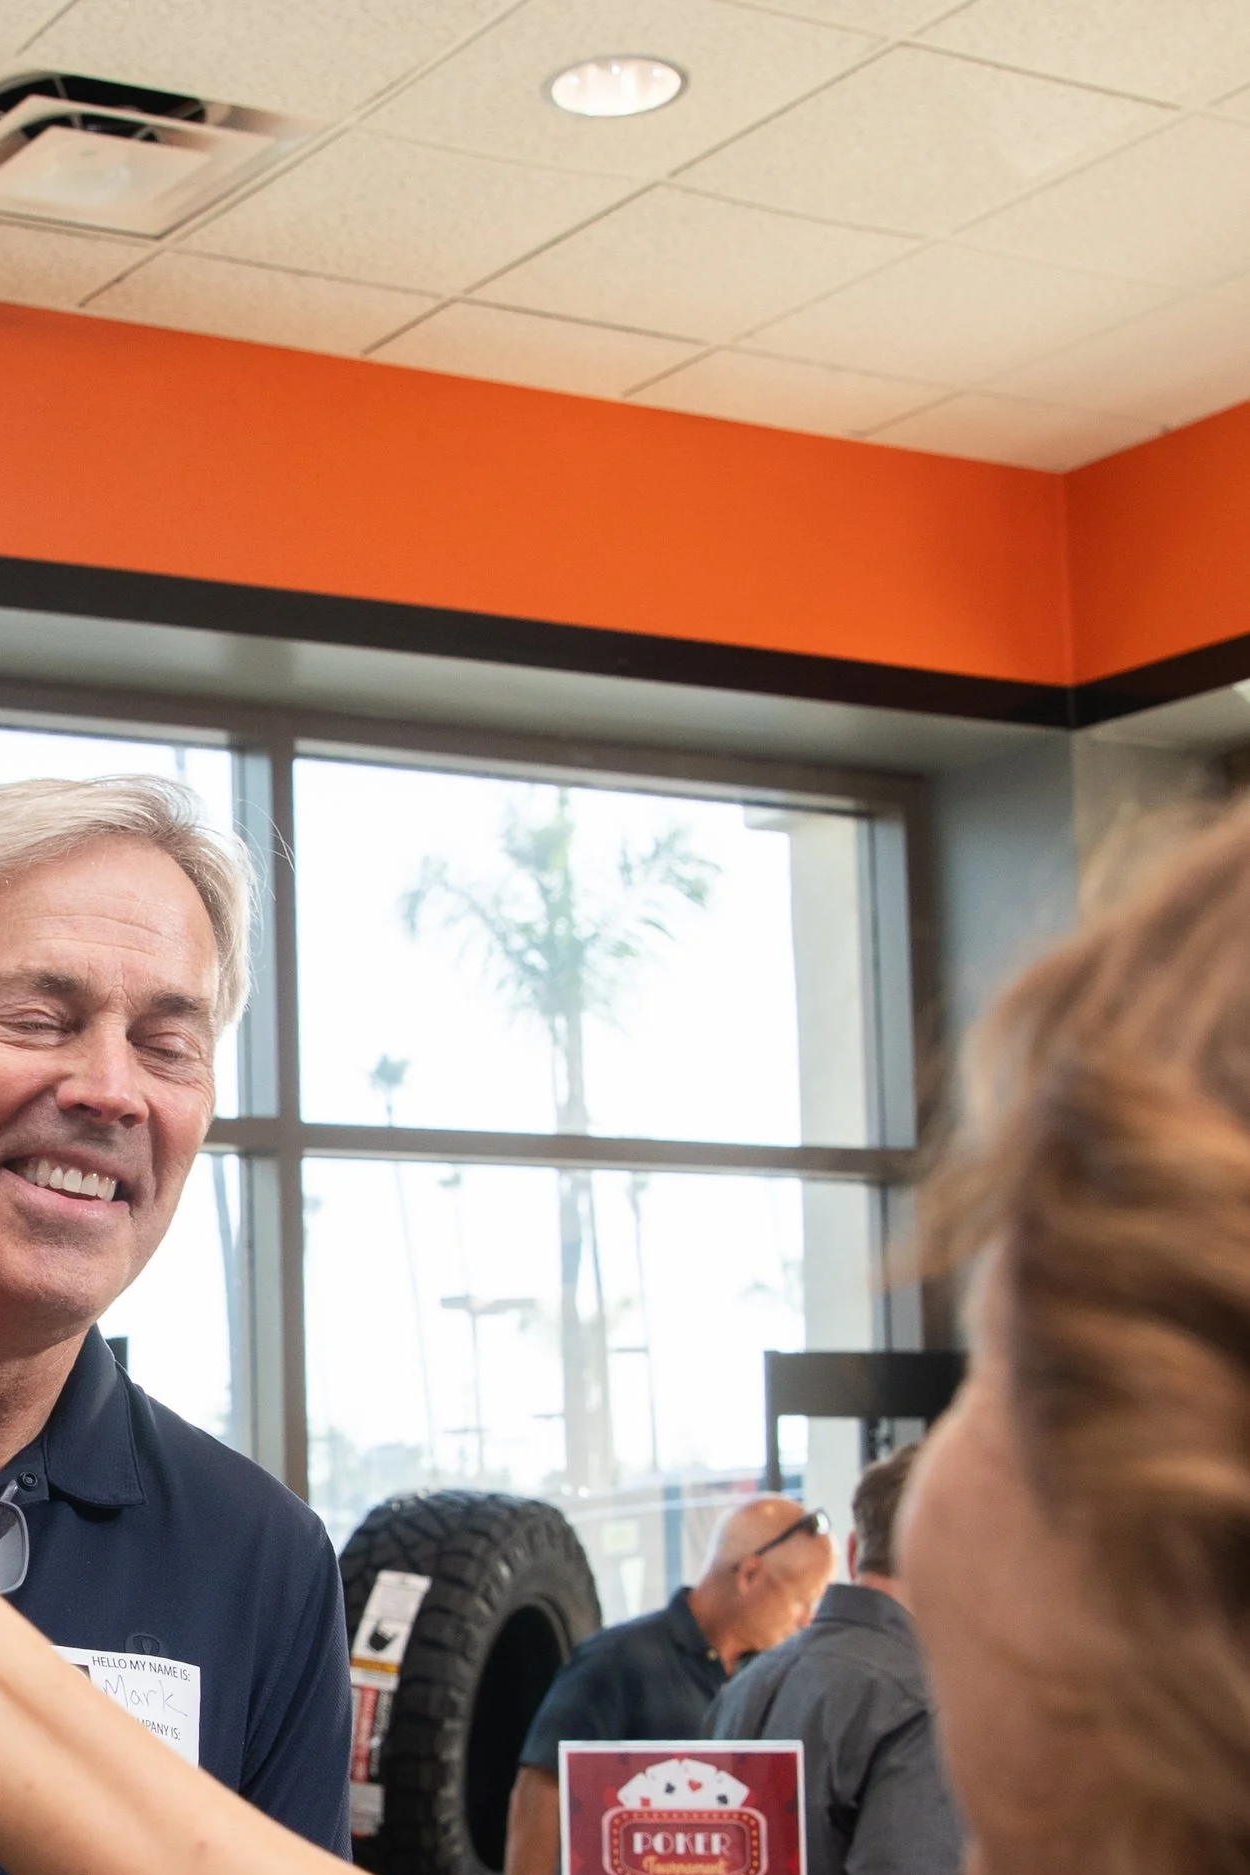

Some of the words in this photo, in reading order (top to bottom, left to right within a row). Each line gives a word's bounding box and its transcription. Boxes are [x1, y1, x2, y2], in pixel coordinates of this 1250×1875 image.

[92, 1656, 127, 1669] HELLO
[130, 1660, 146, 1671] MY
[149, 1662, 178, 1678] NAME
[180, 1669, 191, 1682] IS:
[103, 1674, 189, 1717] Mark
[136, 1717, 169, 1736] MPANY
[171, 1726, 181, 1741] IS:
[633, 1832, 731, 1855] POKER
